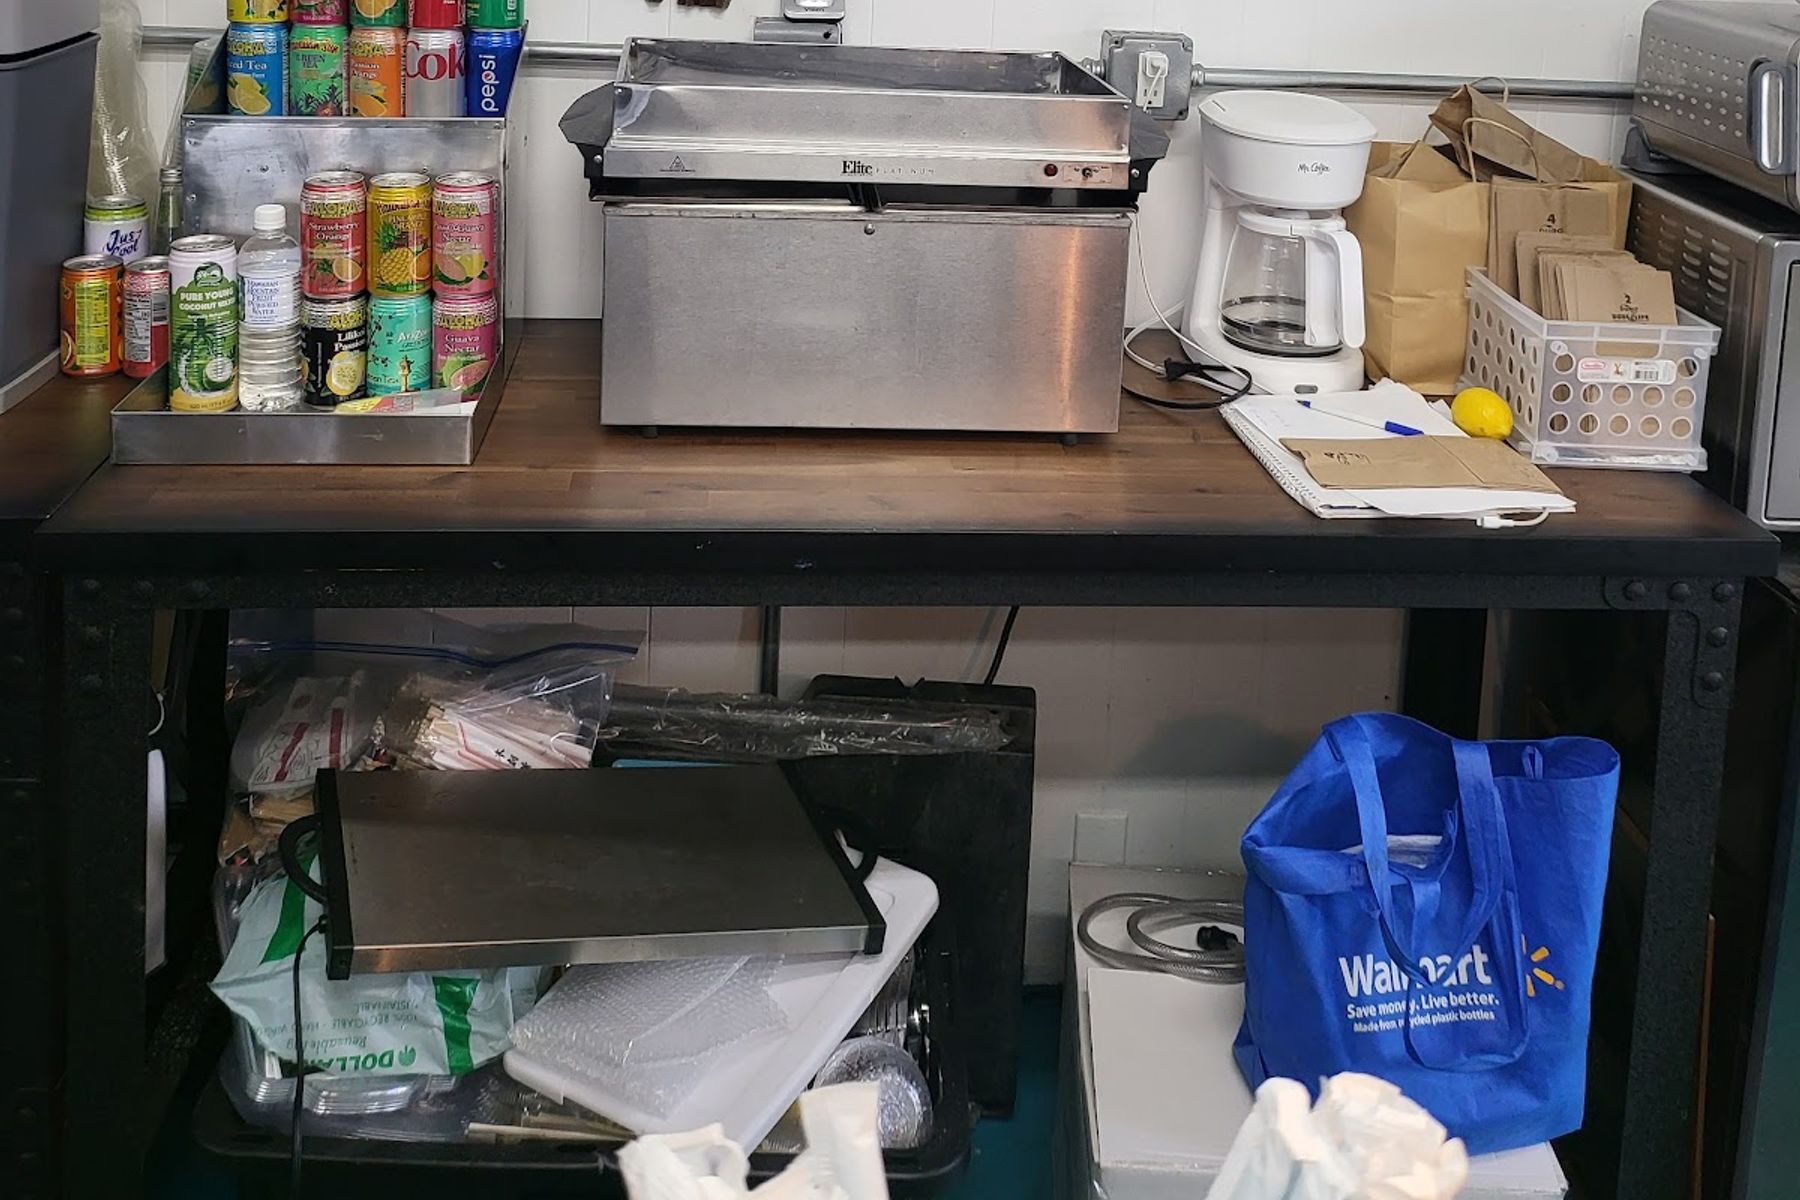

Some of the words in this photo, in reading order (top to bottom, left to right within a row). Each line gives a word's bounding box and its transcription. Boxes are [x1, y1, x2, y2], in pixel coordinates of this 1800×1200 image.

[246, 59, 268, 71] Tea
[479, 54, 500, 112] pepsi
[841, 160, 873, 175] Elite
[1546, 213, 1557, 225] 4
[308, 222, 359, 232] Strawberry
[180, 291, 204, 302] PURE
[1623, 292, 1633, 304] 2
[179, 301, 217, 311] COCONUT
[445, 334, 480, 343] Guava
[445, 344, 480, 353] Nectar
[1347, 1003, 1377, 1019] Save
[1421, 994, 1449, 1010] Live
[1449, 990, 1500, 1006] better.
[1459, 1009, 1495, 1021] bottles
